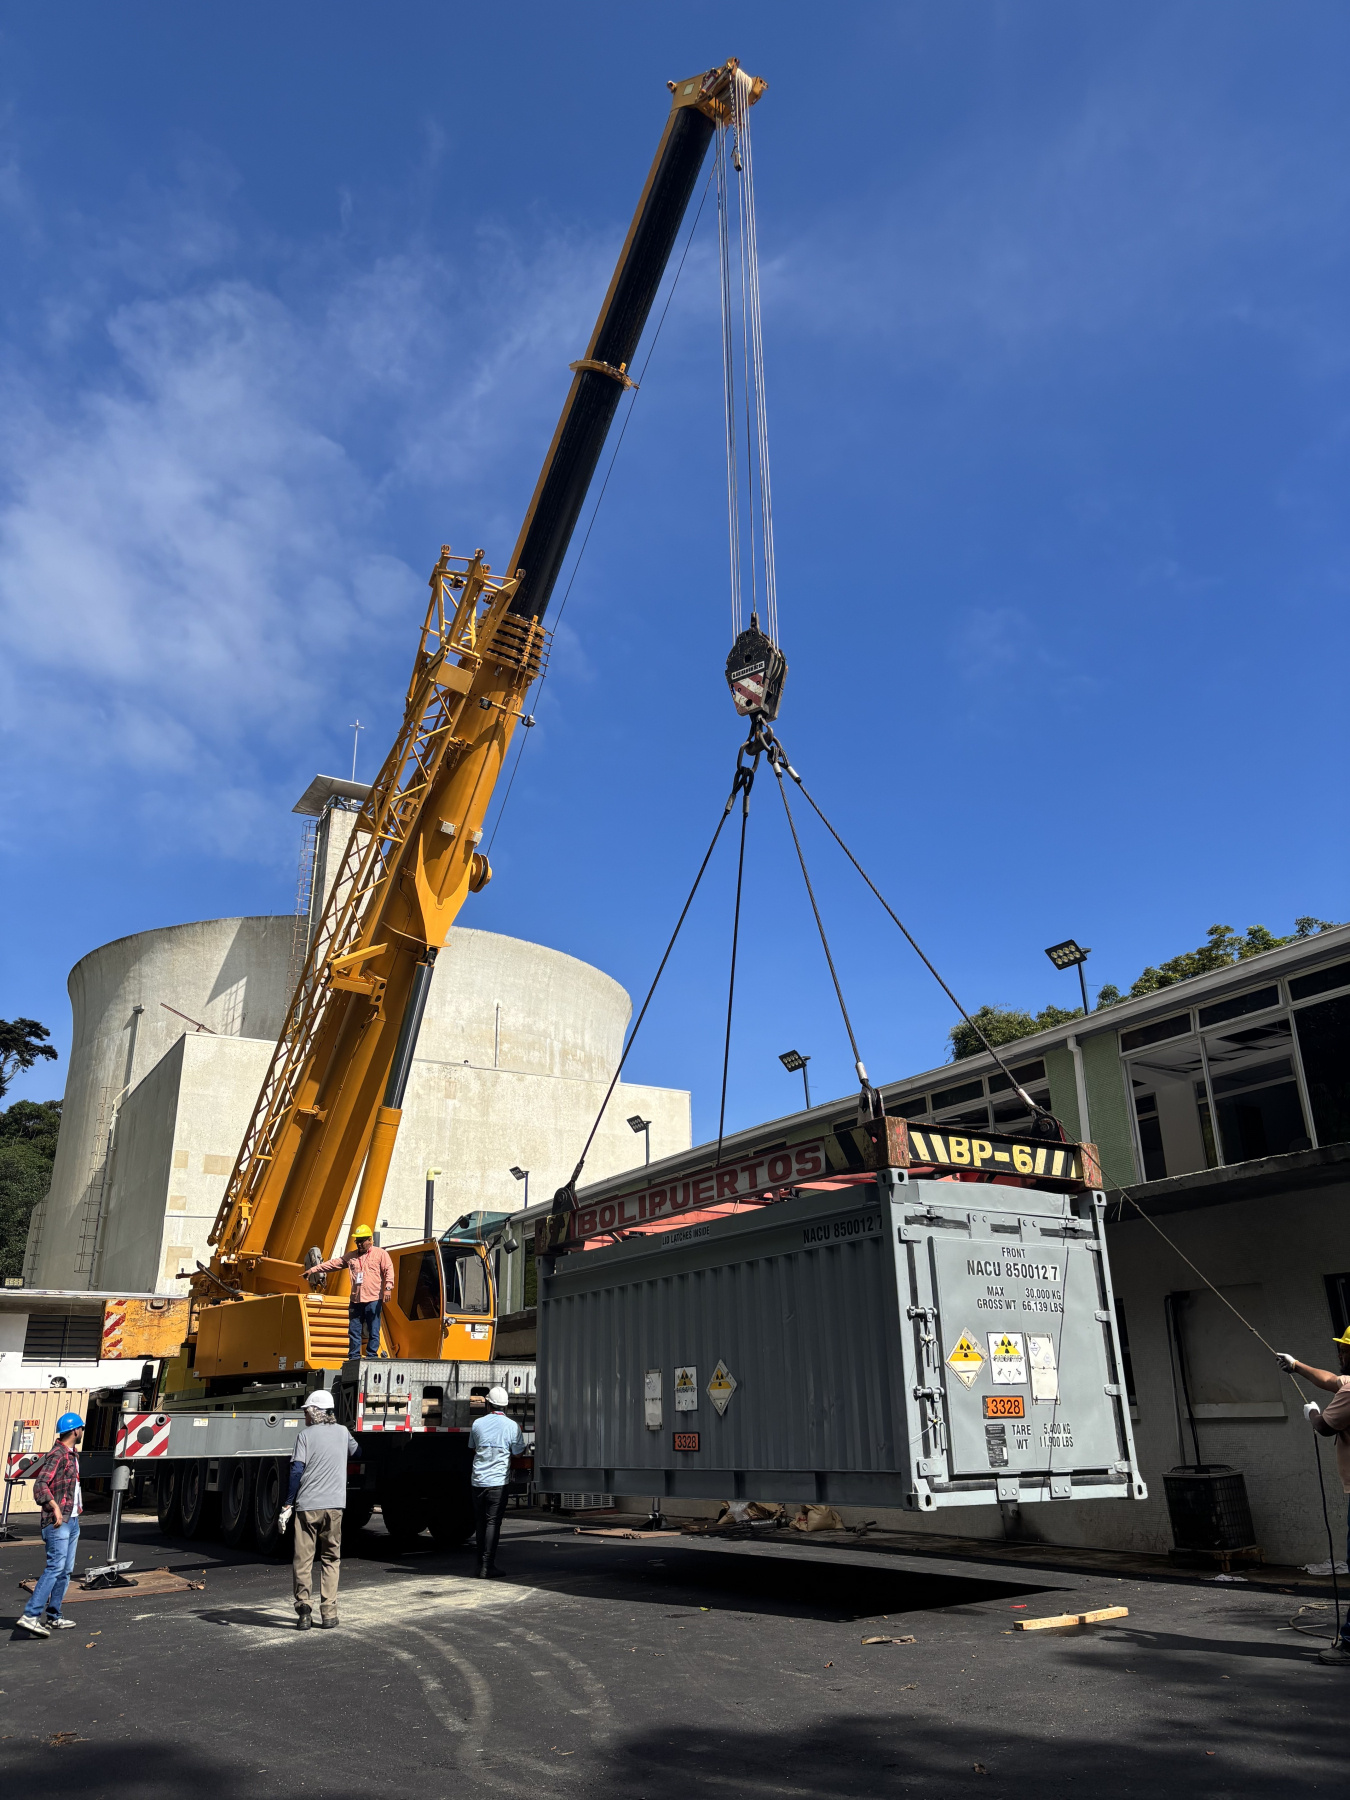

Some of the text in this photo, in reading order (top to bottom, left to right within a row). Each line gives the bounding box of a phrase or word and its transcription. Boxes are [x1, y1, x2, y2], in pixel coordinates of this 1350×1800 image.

[949, 1136, 1033, 1174] BP-6
[577, 1145, 822, 1236] BOLIPUERTOS
[662, 1226, 710, 1245] LID LATCHES INSIDE
[803, 1224, 830, 1244] NACU
[1001, 1247, 1025, 1258] FRONT
[967, 1260, 1001, 1276] NACU
[986, 1286, 1004, 1297] MAX
[1052, 1290, 1062, 1300] KG
[977, 1299, 1063, 1313] GROSS WT 66,139 LBS
[991, 1399, 1020, 1415] 3328
[1011, 1424, 1032, 1435] TARE
[1063, 1423, 1071, 1434] KG
[677, 1435, 696, 1449] 3328
[1016, 1439, 1028, 1449] WT
[1062, 1436, 1074, 1447] LBS
